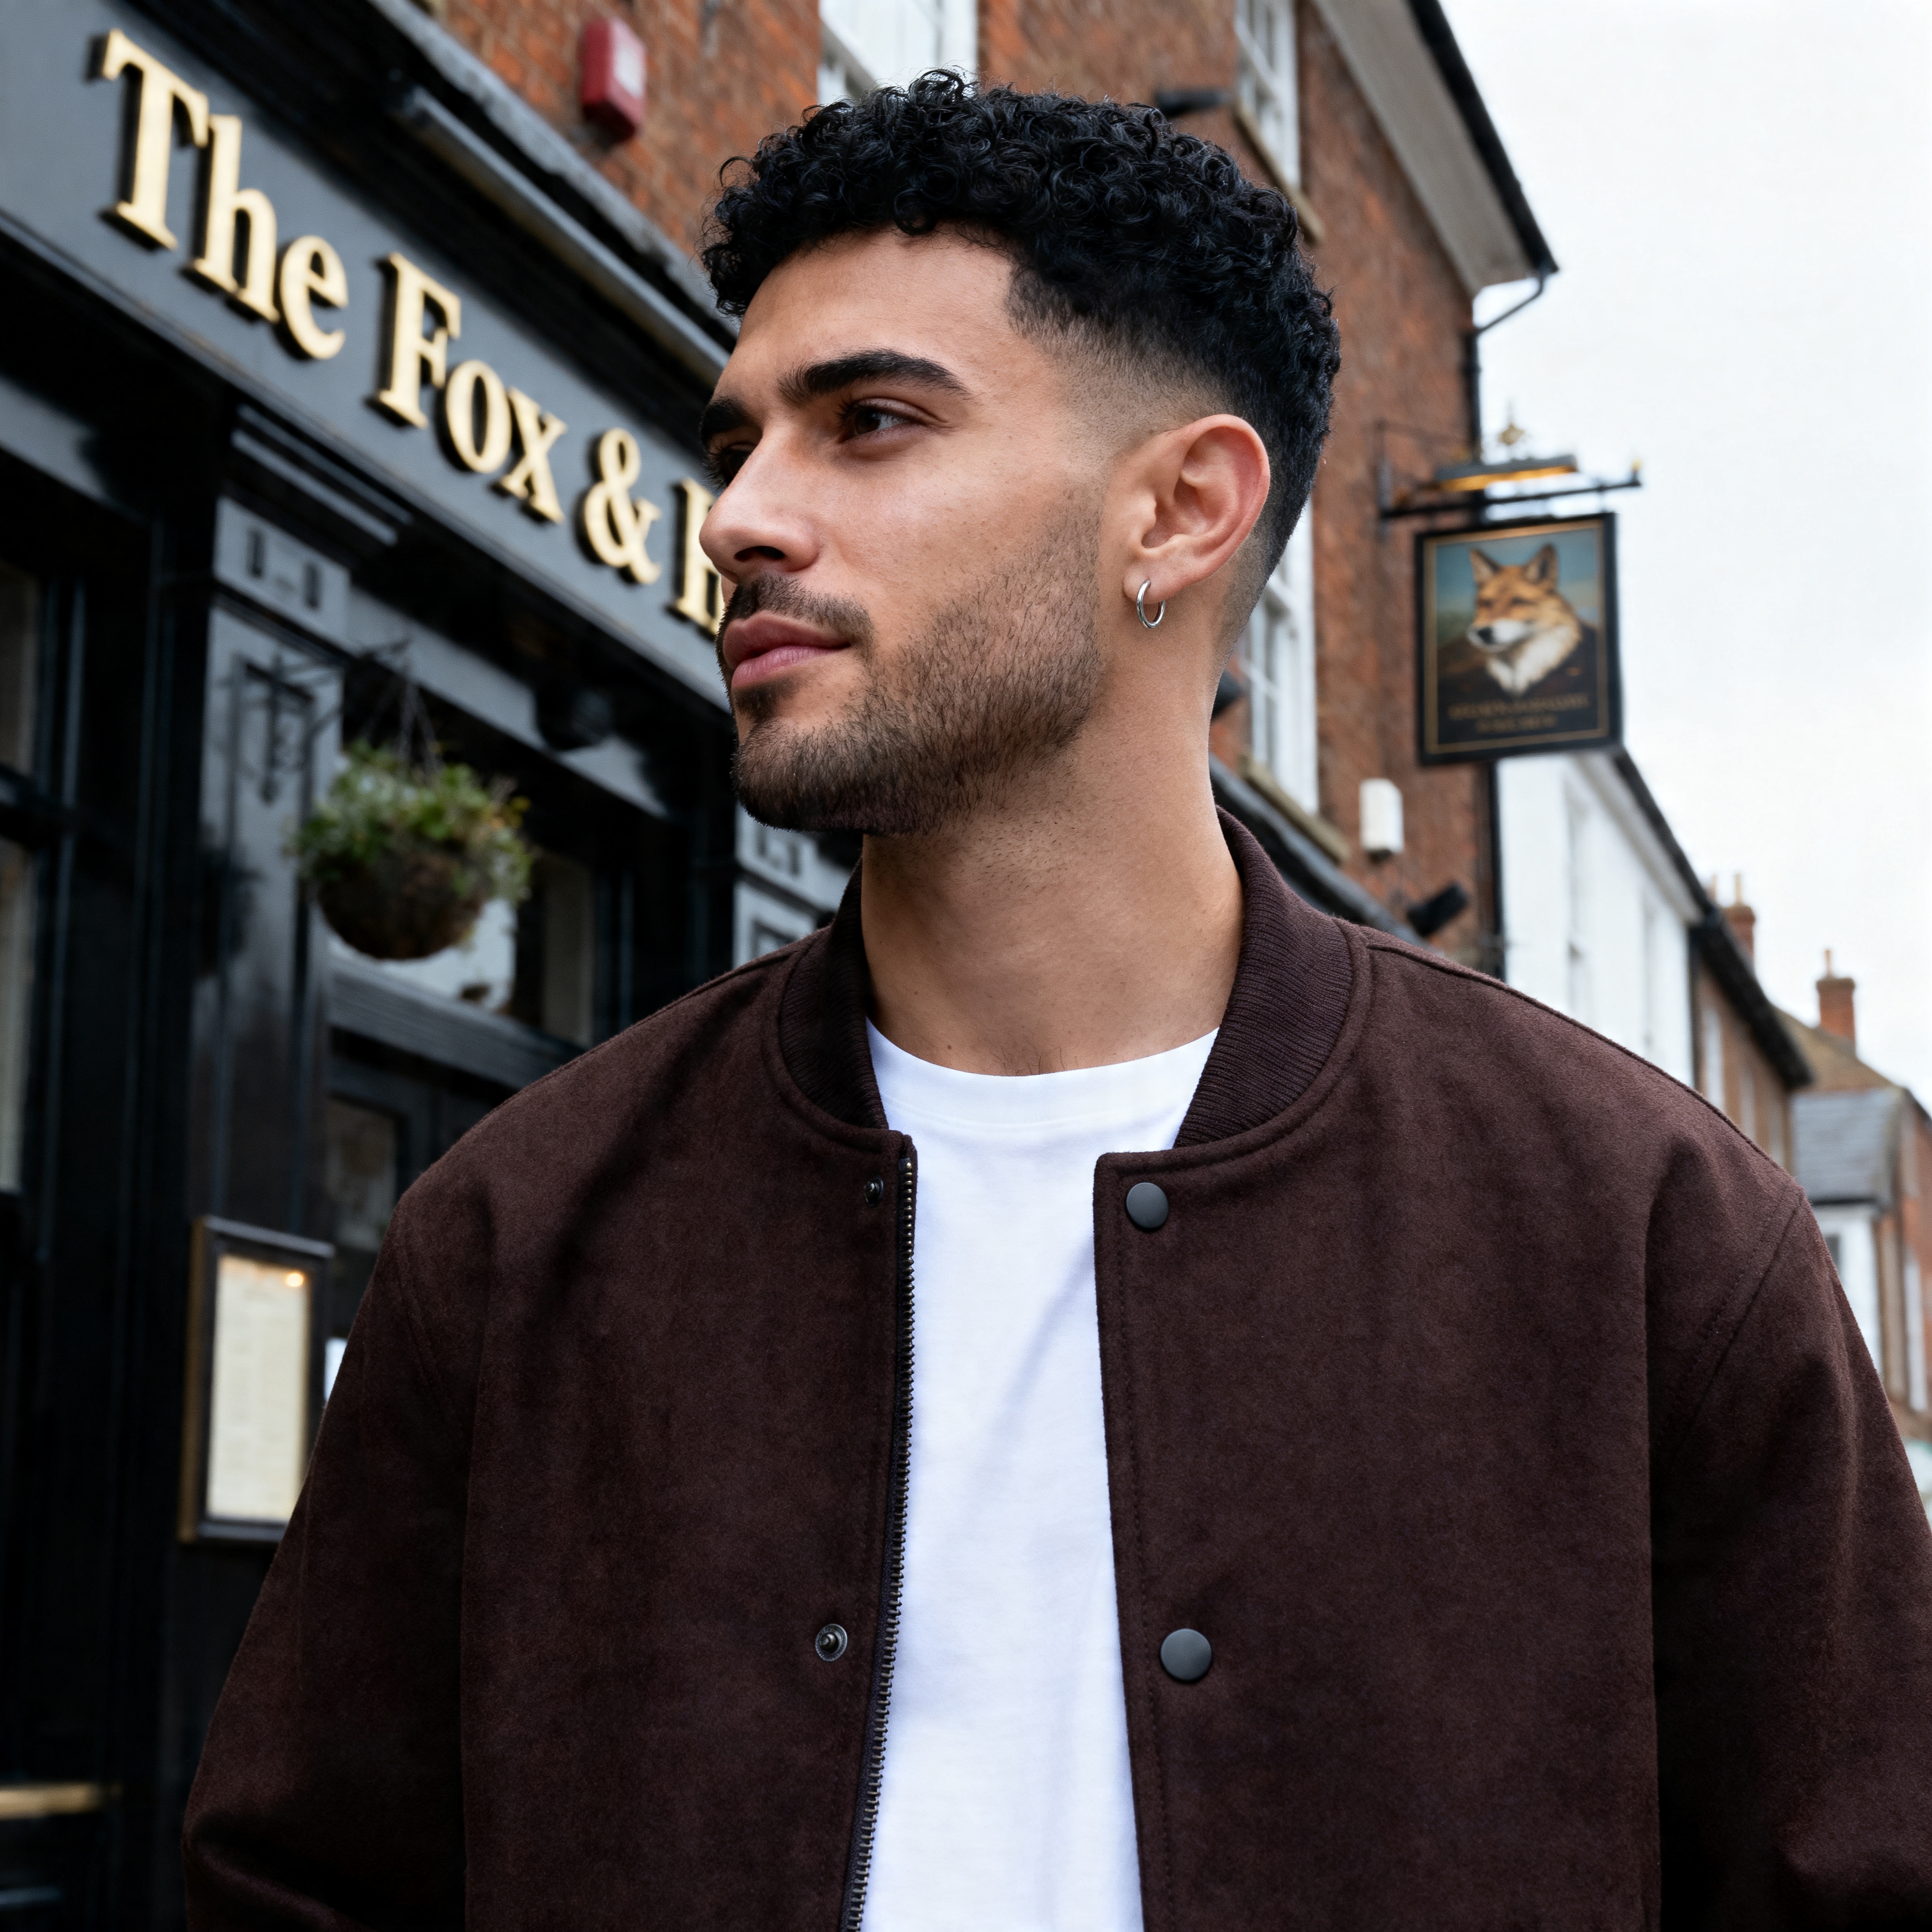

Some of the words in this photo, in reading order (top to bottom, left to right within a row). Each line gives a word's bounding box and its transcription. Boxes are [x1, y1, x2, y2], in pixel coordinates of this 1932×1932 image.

[102, 28, 349, 360] The
[379, 252, 567, 524] Fox
[584, 427, 661, 585] &
